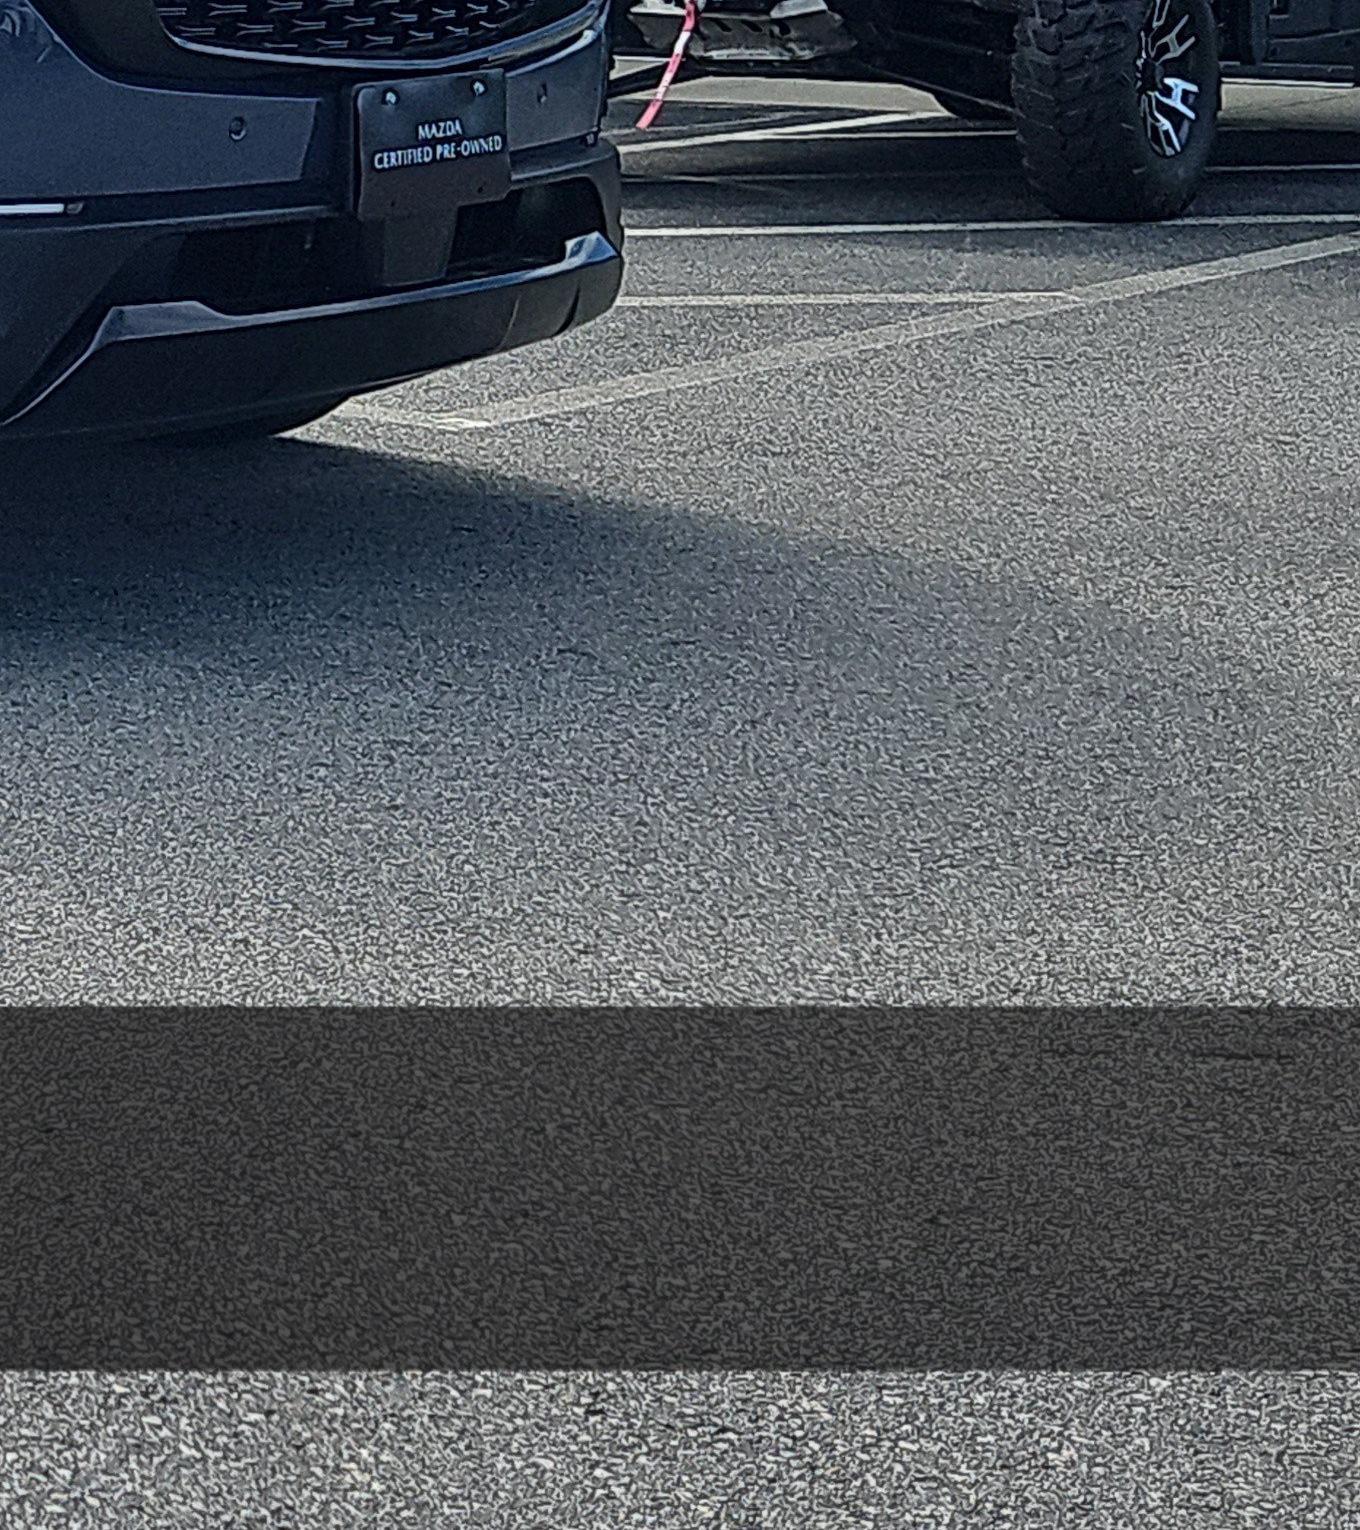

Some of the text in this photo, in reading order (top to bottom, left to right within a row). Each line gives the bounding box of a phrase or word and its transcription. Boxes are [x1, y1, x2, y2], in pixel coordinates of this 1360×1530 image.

[417, 119, 462, 140] MAZDA
[374, 135, 502, 169] CERTIFIED PRE-OWNED
